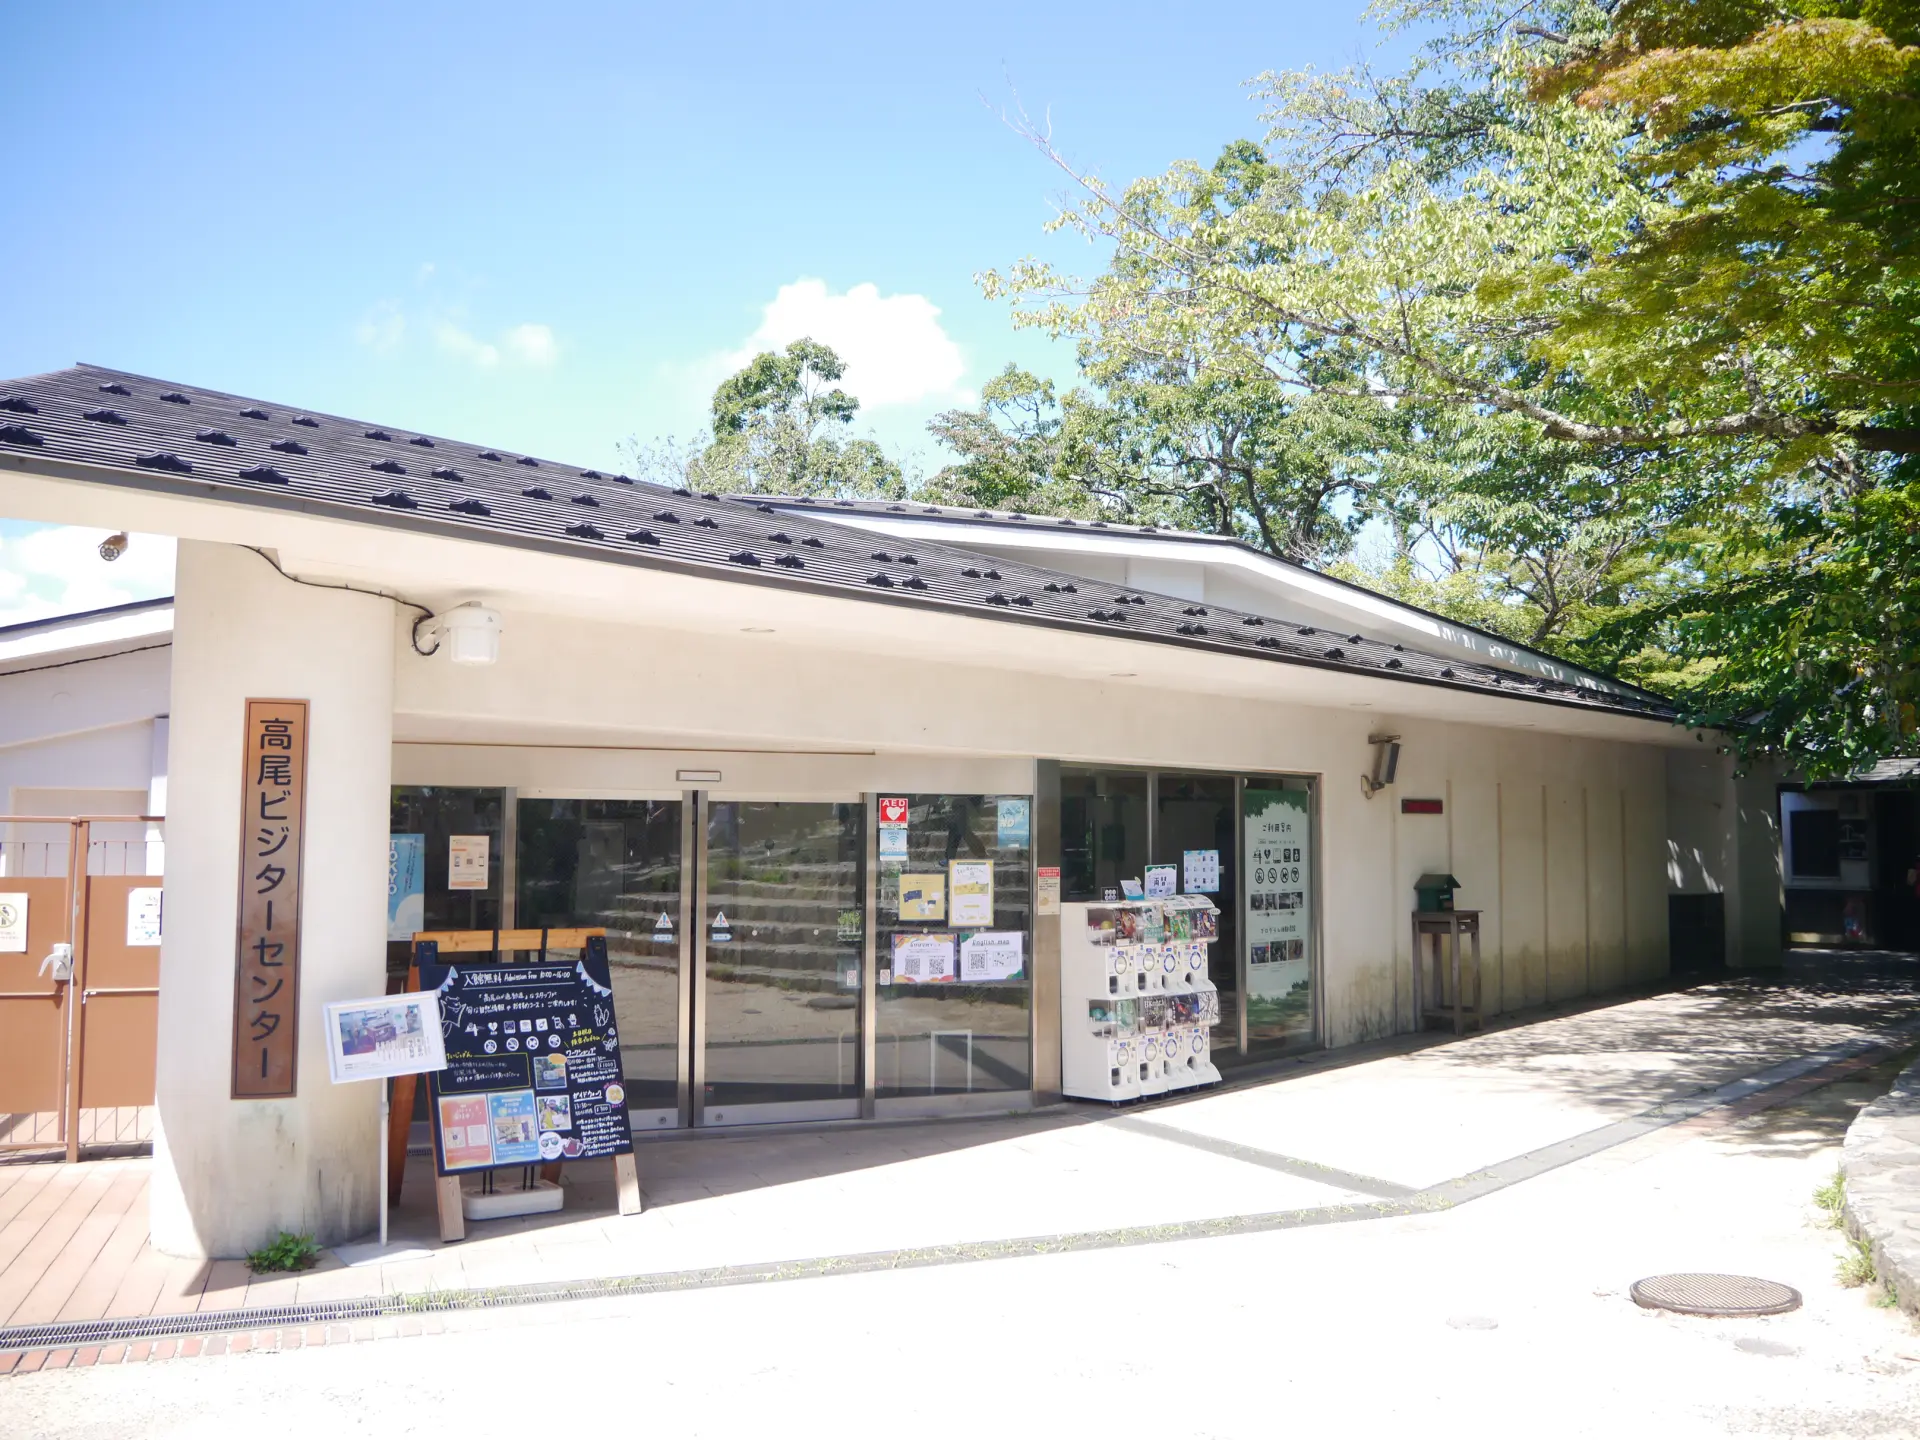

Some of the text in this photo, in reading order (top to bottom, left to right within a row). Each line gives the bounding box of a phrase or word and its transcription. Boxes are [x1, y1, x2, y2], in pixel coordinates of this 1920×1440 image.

[882, 799, 906, 807] AED
[249, 717, 294, 1079] 高尾ビジターセンター
